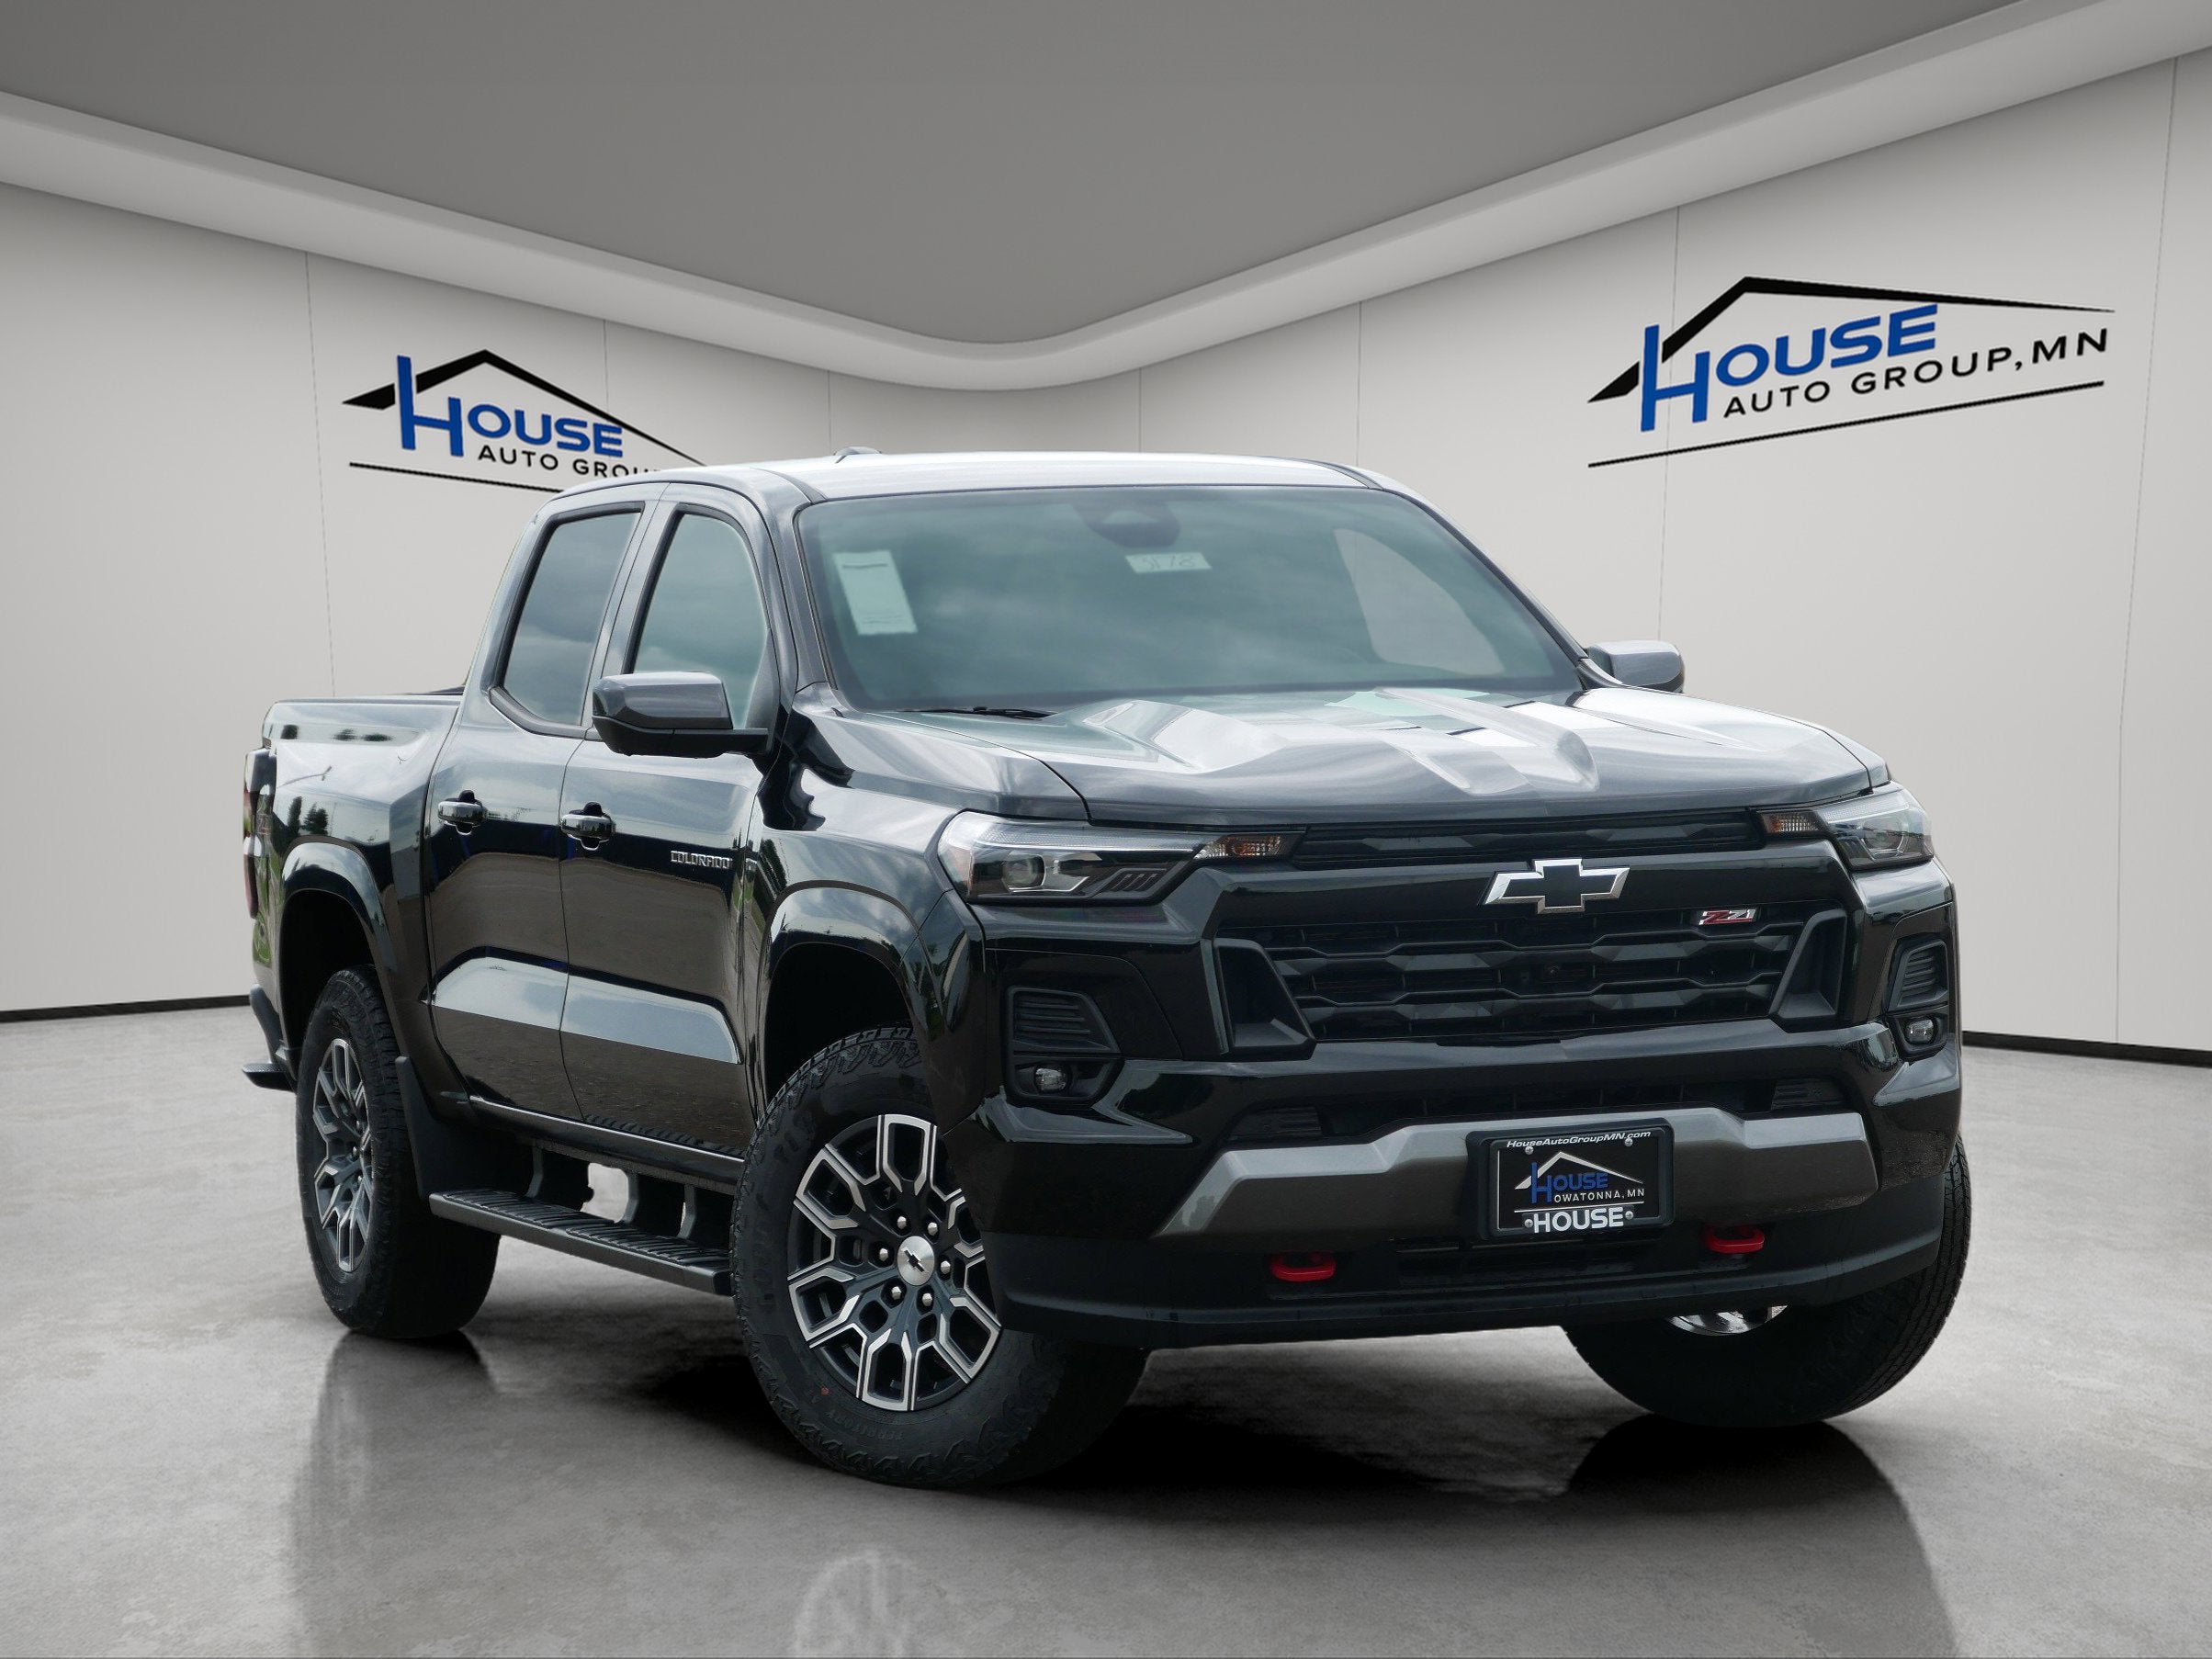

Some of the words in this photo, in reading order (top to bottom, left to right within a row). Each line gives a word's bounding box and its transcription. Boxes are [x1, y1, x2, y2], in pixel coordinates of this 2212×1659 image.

[1641, 303, 1938, 432] HOUSE
[397, 355, 623, 457] HOUSE
[1723, 381, 1831, 418] AUTO
[478, 445, 559, 471] AUTO
[572, 458, 660, 478] GRO
[670, 851, 732, 869] COLORADO
[1698, 908, 1756, 925] Z71
[1507, 1131, 1651, 1148] HouseAutoGroupMN.com
[1530, 1161, 1608, 1204] HOUSE
[1533, 1206, 1624, 1234] HOUSE
